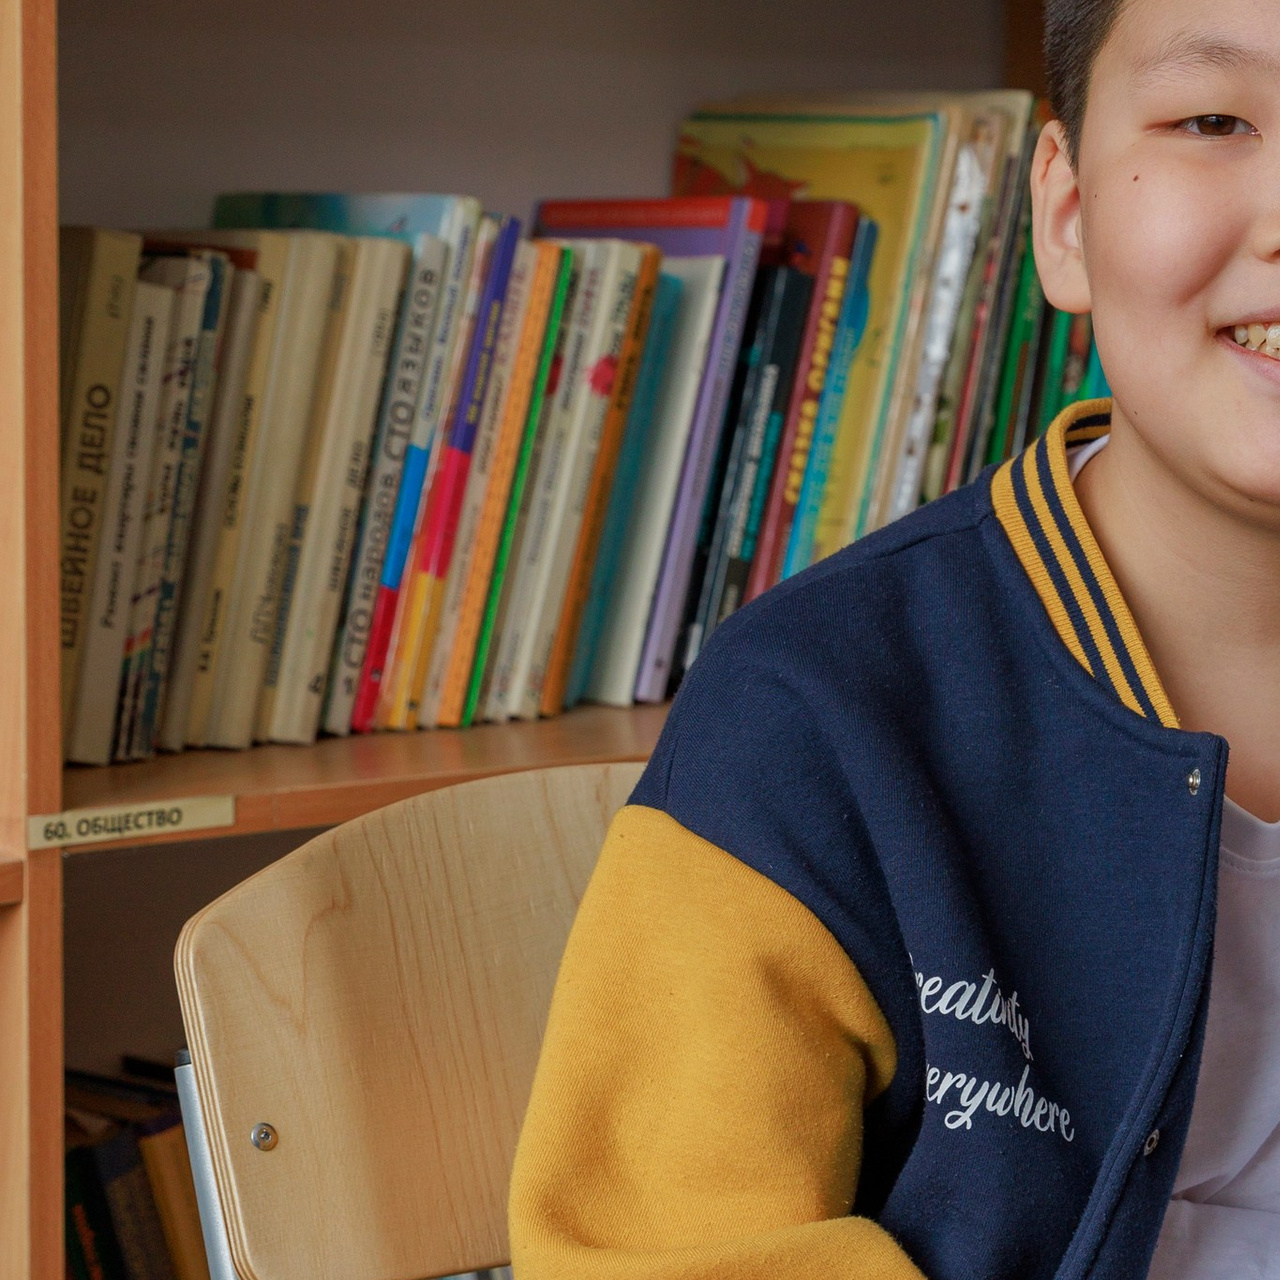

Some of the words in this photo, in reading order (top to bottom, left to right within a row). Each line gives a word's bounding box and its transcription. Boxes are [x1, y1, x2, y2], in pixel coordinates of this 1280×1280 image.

[394, 266, 437, 395] языков
[78, 383, 111, 476] ДЕЛО
[381, 397, 415, 463] СТО
[62, 484, 98, 649] ШВЕЙНОЕ
[340, 607, 371, 670] СТО
[43, 823, 69, 841] 60.
[76, 807, 184, 839] ОБЩЕСТВО
[926, 1061, 1075, 1142] erywhere
